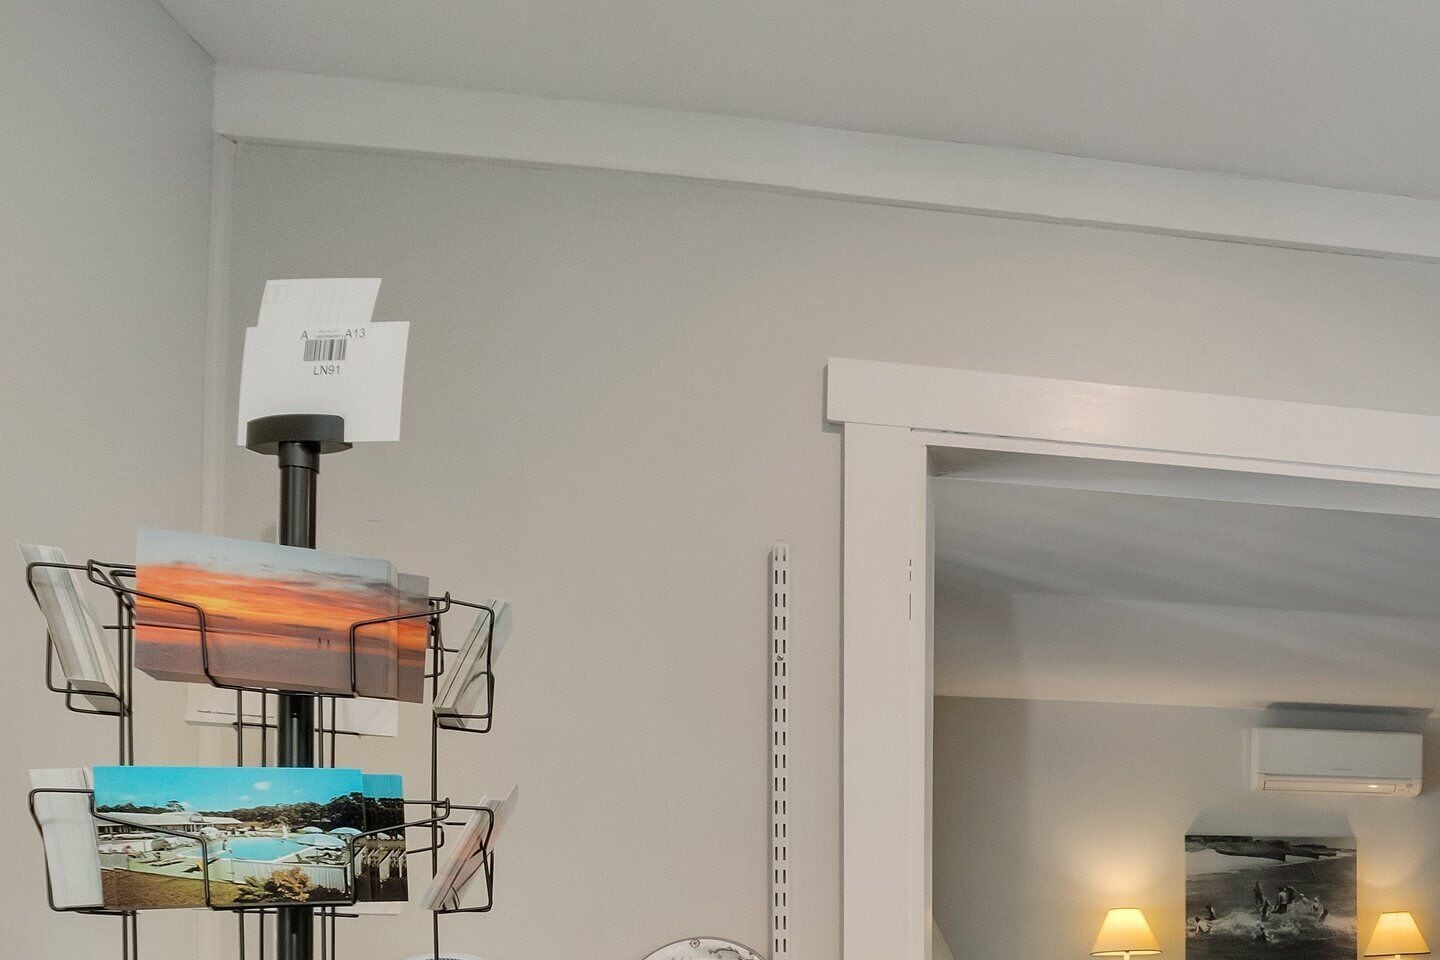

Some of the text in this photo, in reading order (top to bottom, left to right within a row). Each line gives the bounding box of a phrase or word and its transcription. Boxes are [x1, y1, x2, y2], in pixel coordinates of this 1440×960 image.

[300, 330, 309, 340] A
[345, 328, 366, 339] A13
[313, 365, 341, 376] LN91
